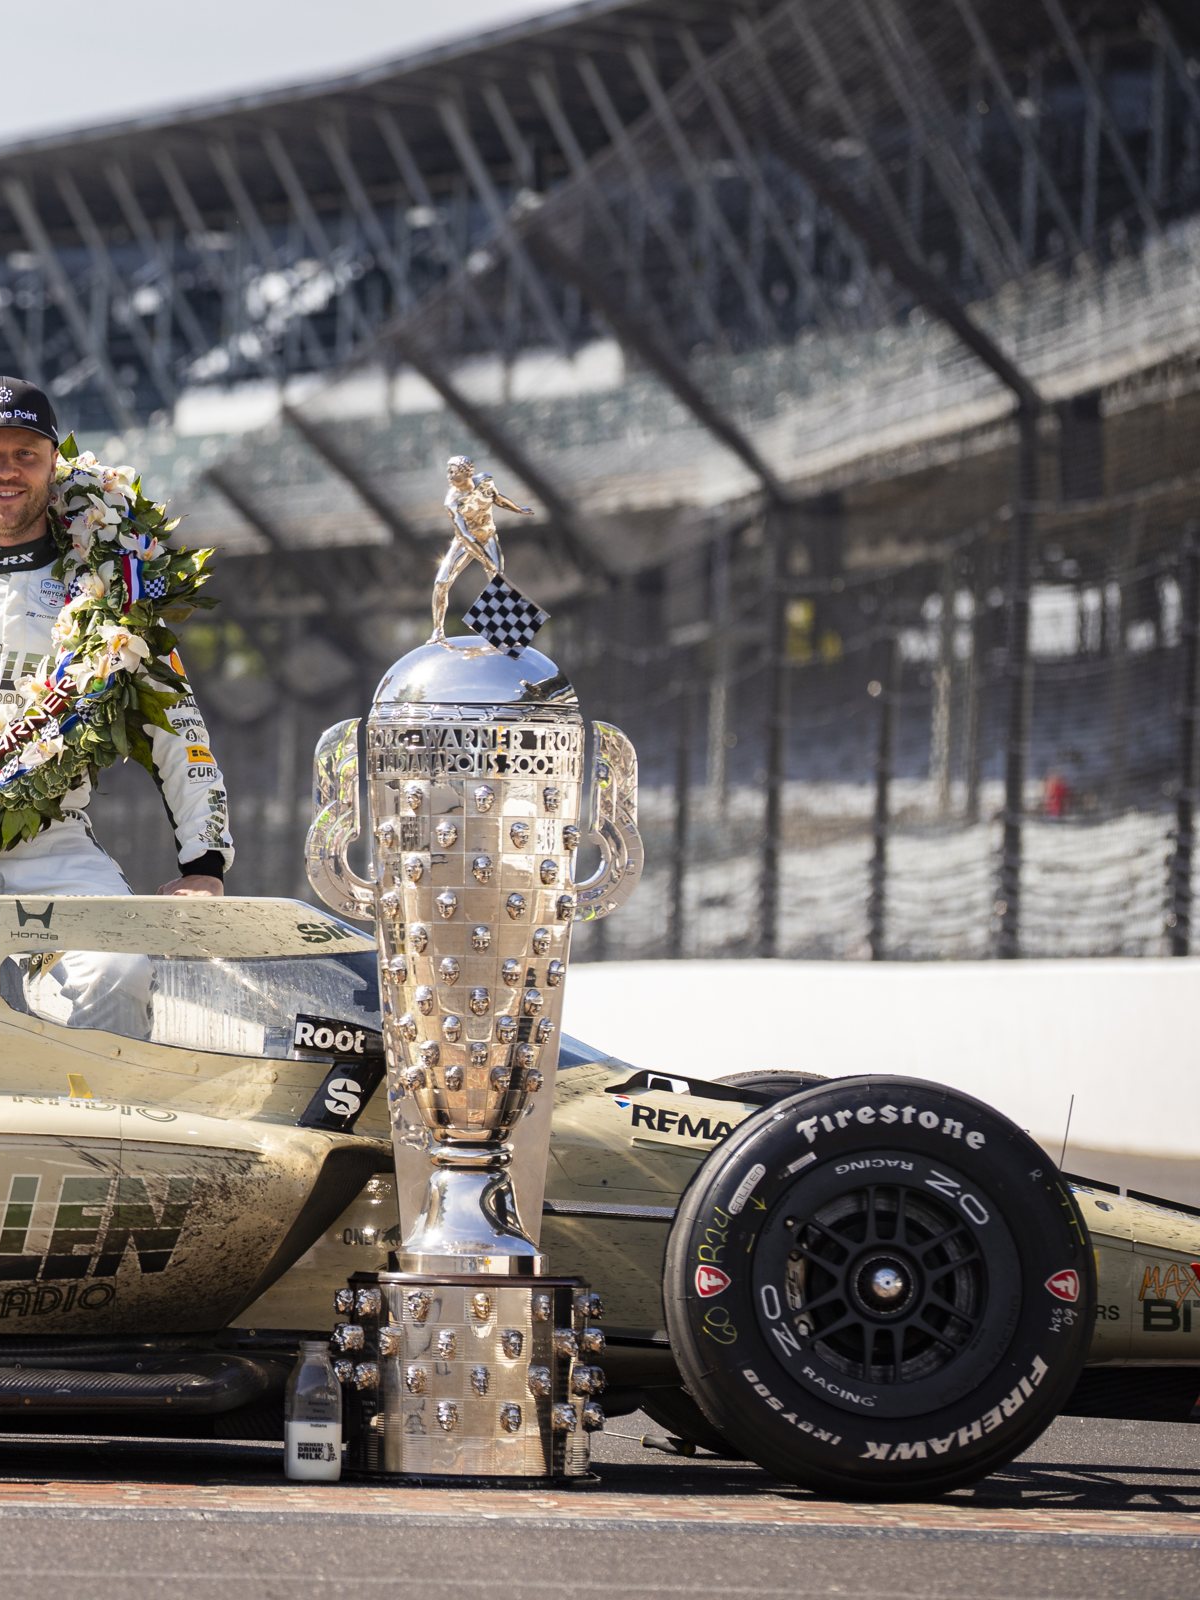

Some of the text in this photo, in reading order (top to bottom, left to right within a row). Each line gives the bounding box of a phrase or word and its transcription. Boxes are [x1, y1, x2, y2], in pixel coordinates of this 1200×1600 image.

[14, 408, 39, 422] Point
[40, 589, 66, 598] INDYCA
[171, 717, 205, 730] Sirius
[10, 931, 59, 941] Honda
[294, 1022, 366, 1054] Root
[631, 1103, 737, 1141] REMA
[796, 1104, 987, 1150] Firestone
[834, 1159, 914, 1175] RACING
[730, 1165, 765, 1213] ENLITEN
[1143, 1300, 1200, 1333] BI
[801, 1365, 877, 1408] RACING
[742, 1354, 1050, 1461] FIREHAWK INDY 500
[297, 1452, 322, 1460] MILK
